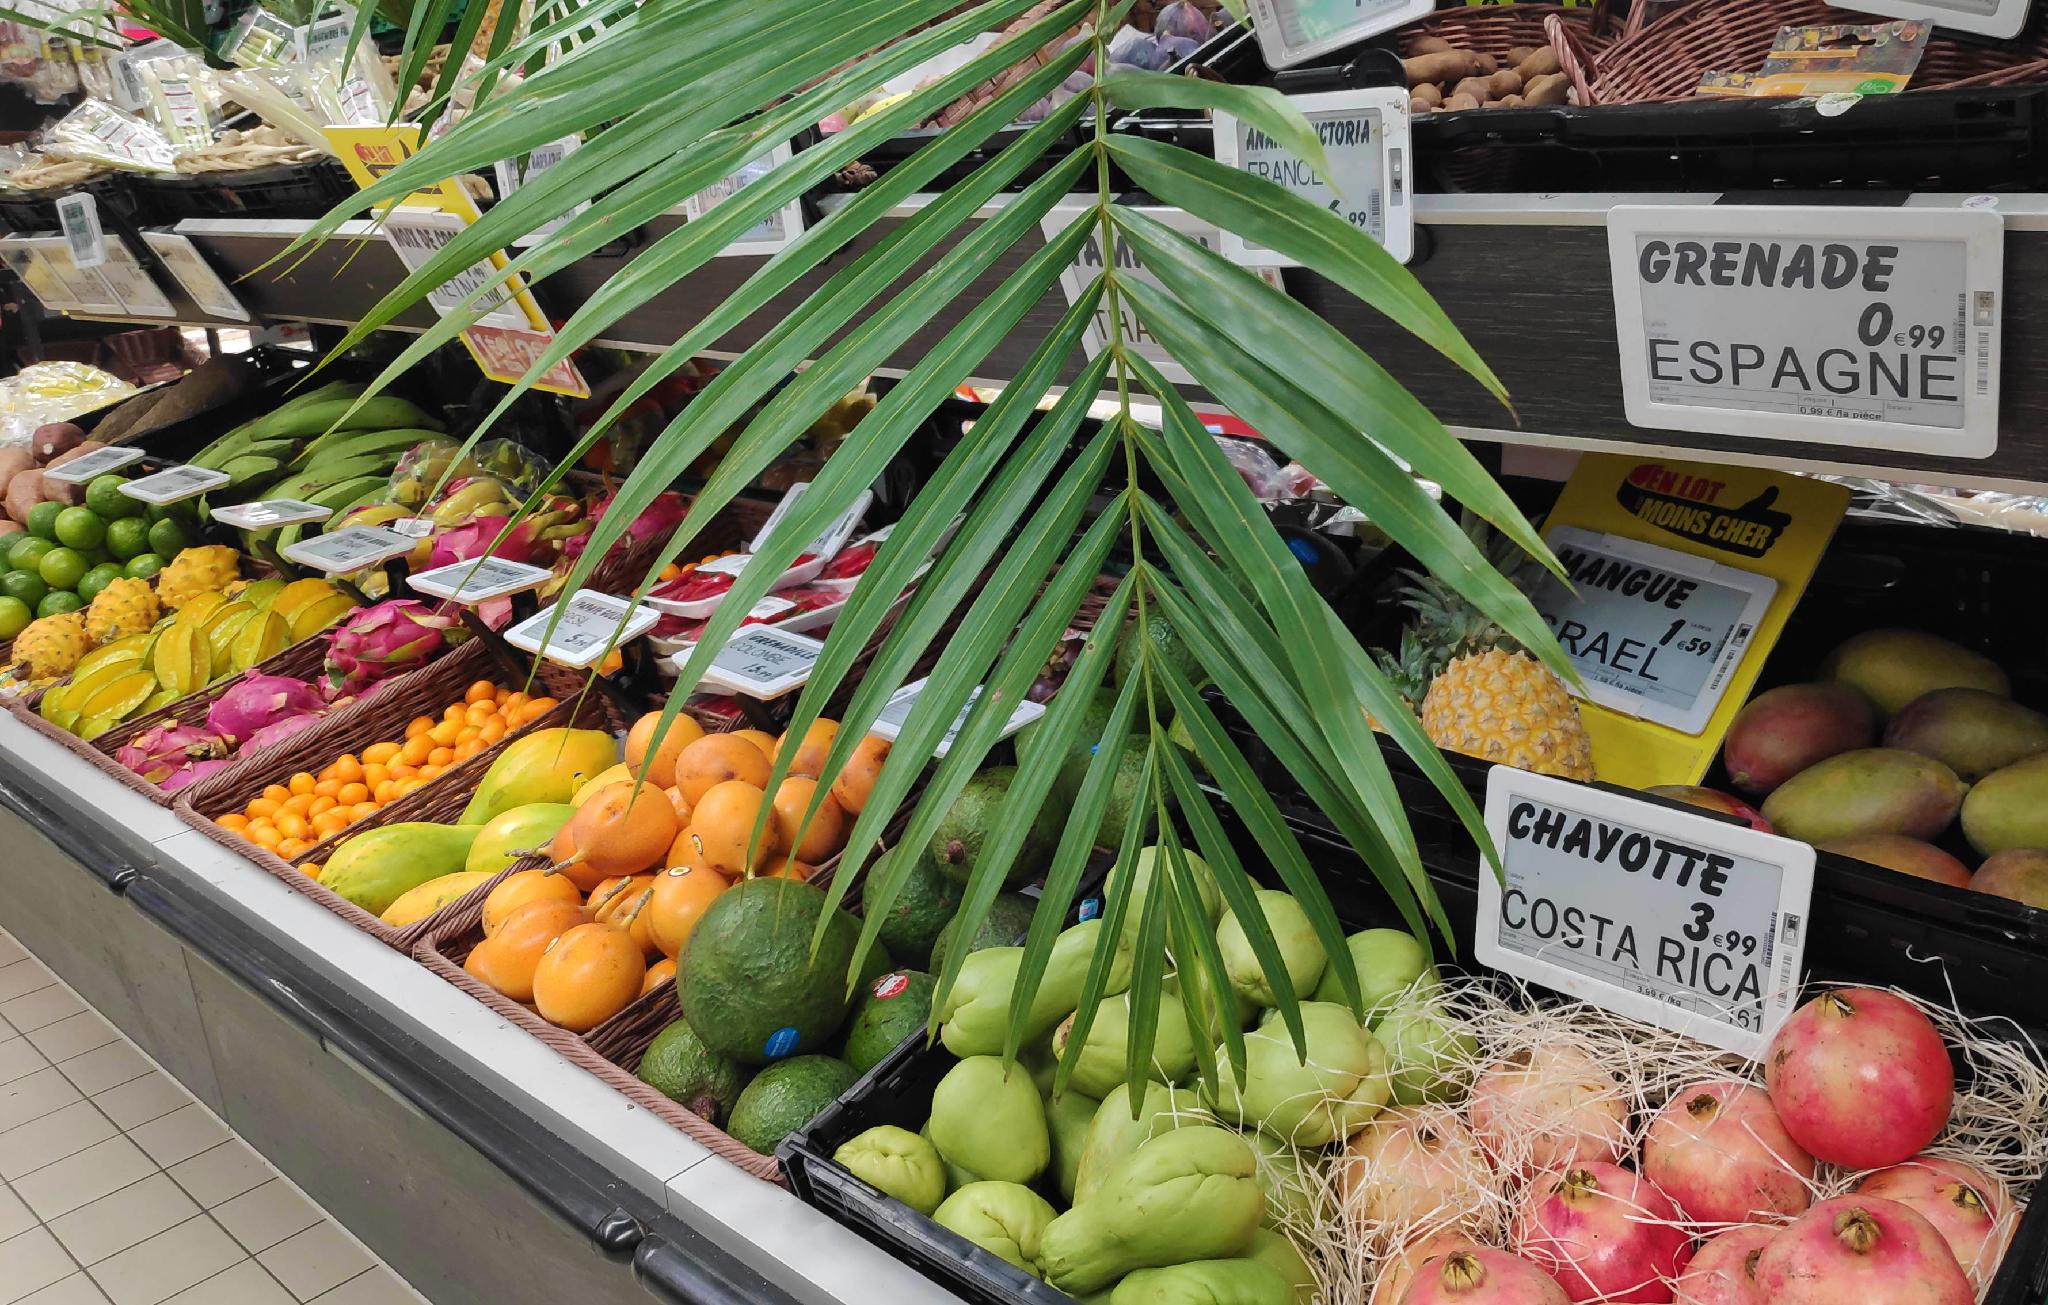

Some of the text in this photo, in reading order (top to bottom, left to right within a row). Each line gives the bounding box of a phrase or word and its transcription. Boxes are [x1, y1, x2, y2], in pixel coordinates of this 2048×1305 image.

[1638, 240, 1899, 292] GRENADE
[1648, 337, 1959, 402] ESPAGNE
[1678, 474, 1727, 503] LOT
[1637, 497, 1712, 539] MOINS
[1708, 515, 1773, 551] CHER
[1557, 547, 1698, 610] MANGUE
[749, 634, 819, 660] GRENADILLE
[1547, 611, 1660, 681] RAEL
[1507, 801, 1735, 898] CHAYOTTE
[1501, 888, 1763, 1010] COSTA RICA
